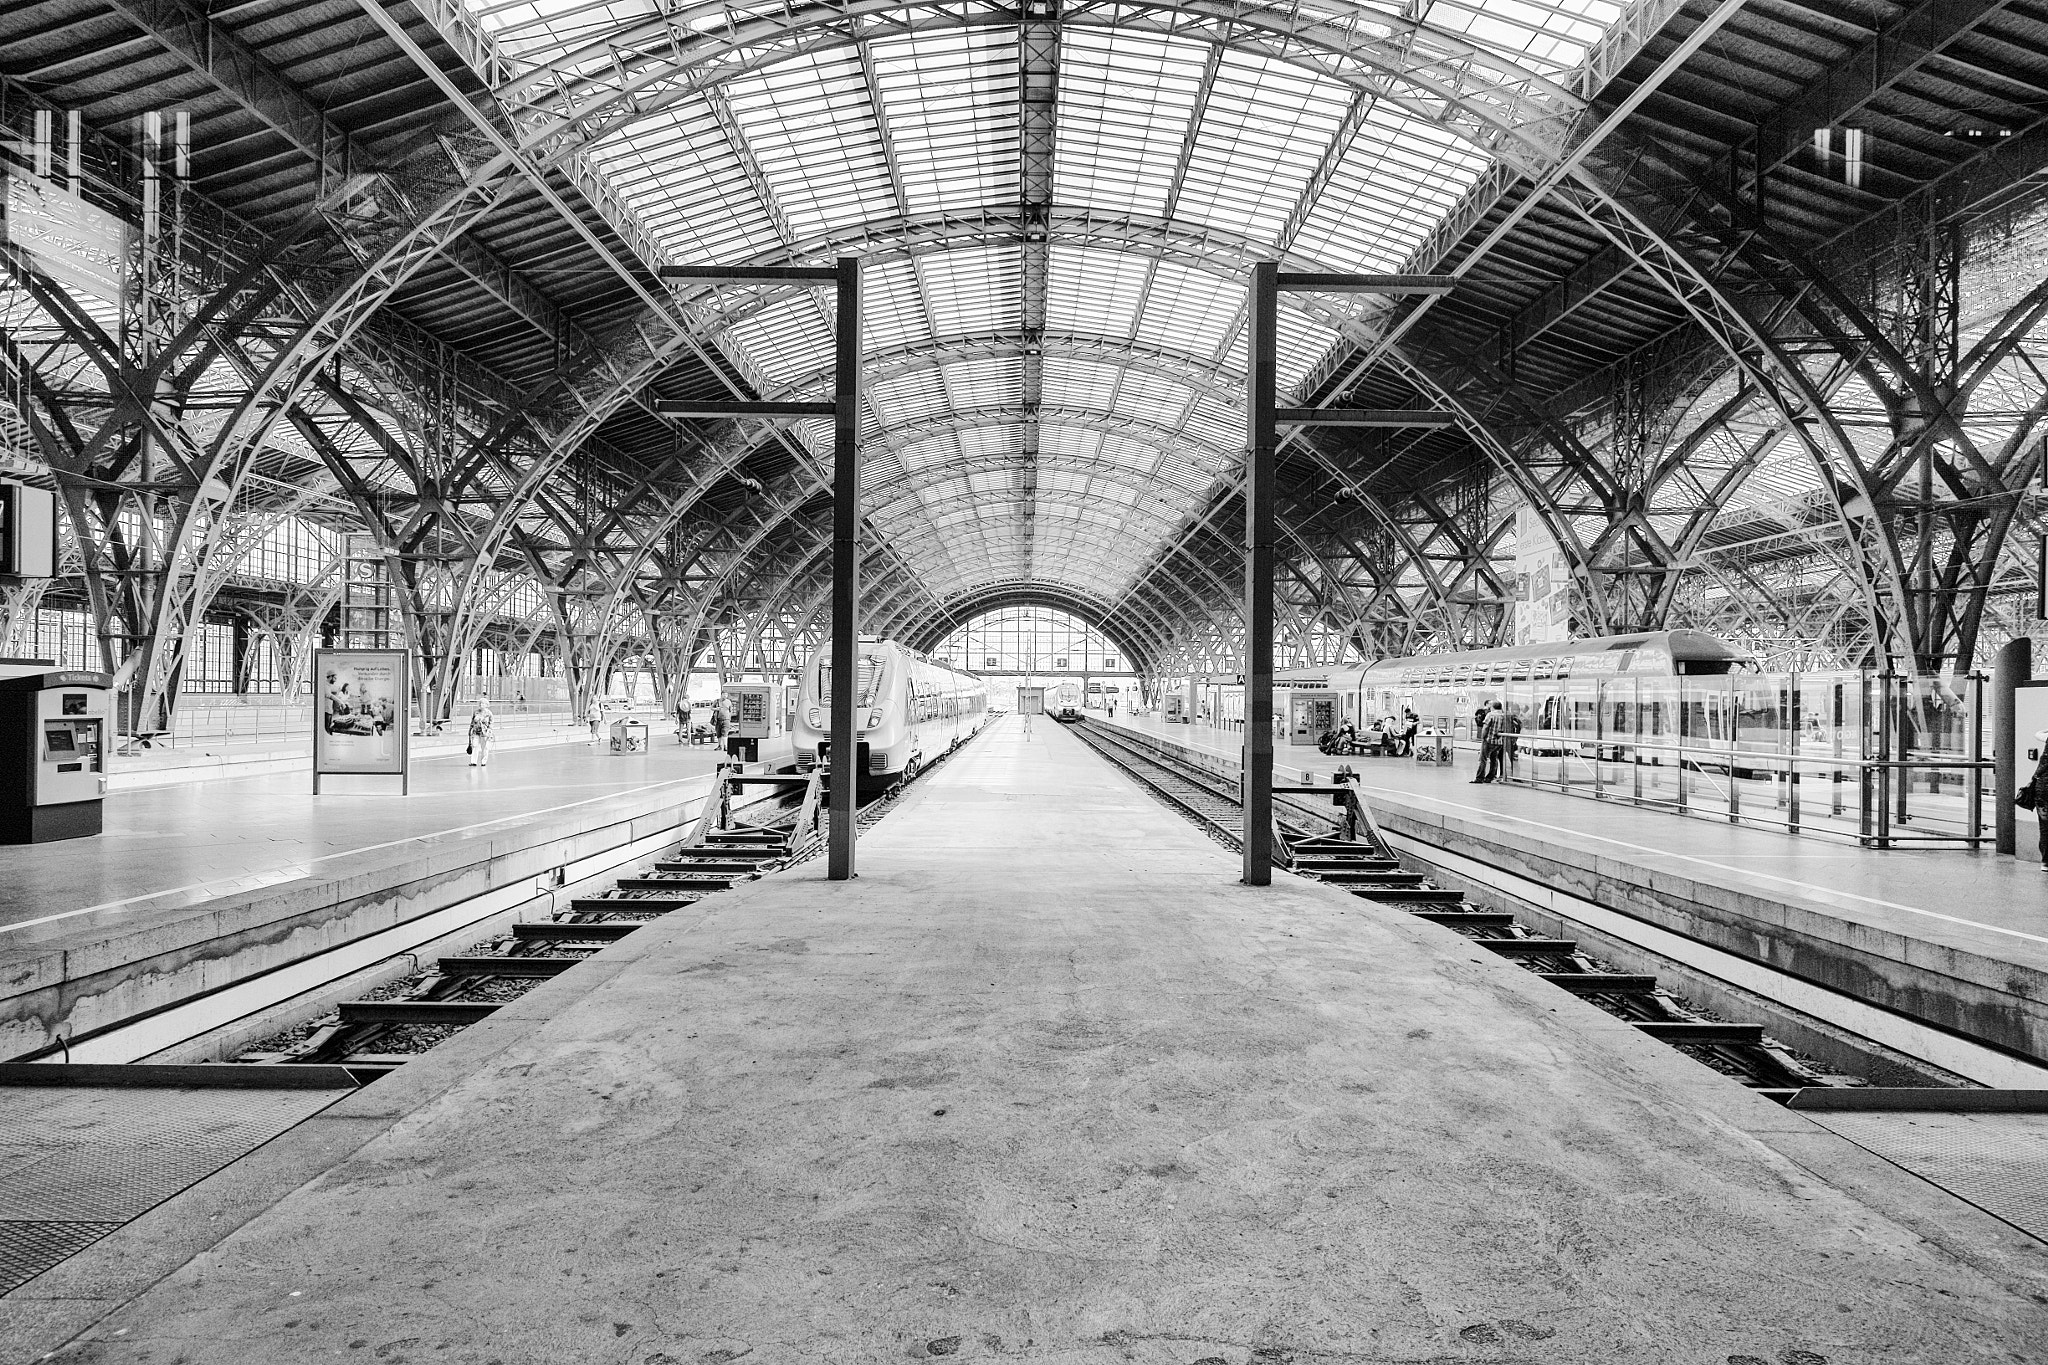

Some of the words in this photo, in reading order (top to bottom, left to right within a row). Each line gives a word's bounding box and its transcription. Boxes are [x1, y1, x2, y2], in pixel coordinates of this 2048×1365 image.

[360, 563, 373, 578] S
[1238, 675, 1245, 684] A
[1305, 773, 1310, 781] 8
